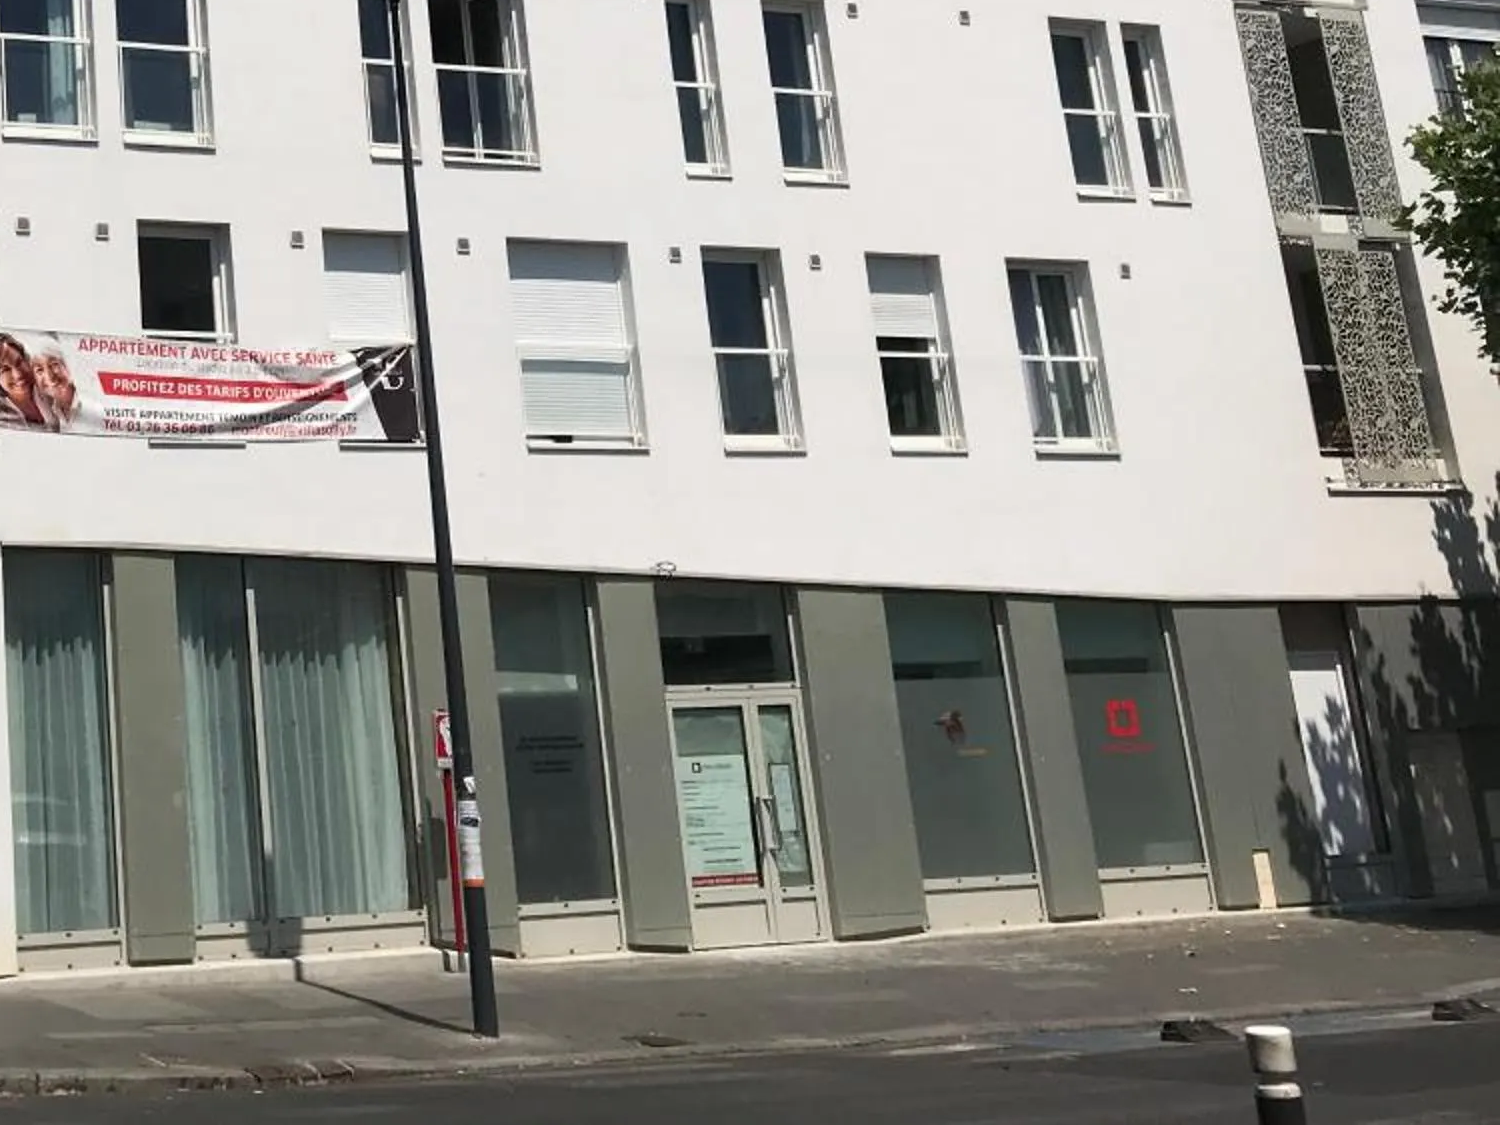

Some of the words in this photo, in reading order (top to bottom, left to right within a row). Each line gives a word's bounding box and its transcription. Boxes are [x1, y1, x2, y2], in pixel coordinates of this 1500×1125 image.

[78, 338, 187, 360] APPARTEMENT
[190, 346, 228, 362] AVEC
[231, 349, 291, 364] SERVICE
[112, 378, 175, 394] PROFITEZ
[177, 383, 202, 396] DES
[204, 384, 250, 398] TARIFS
